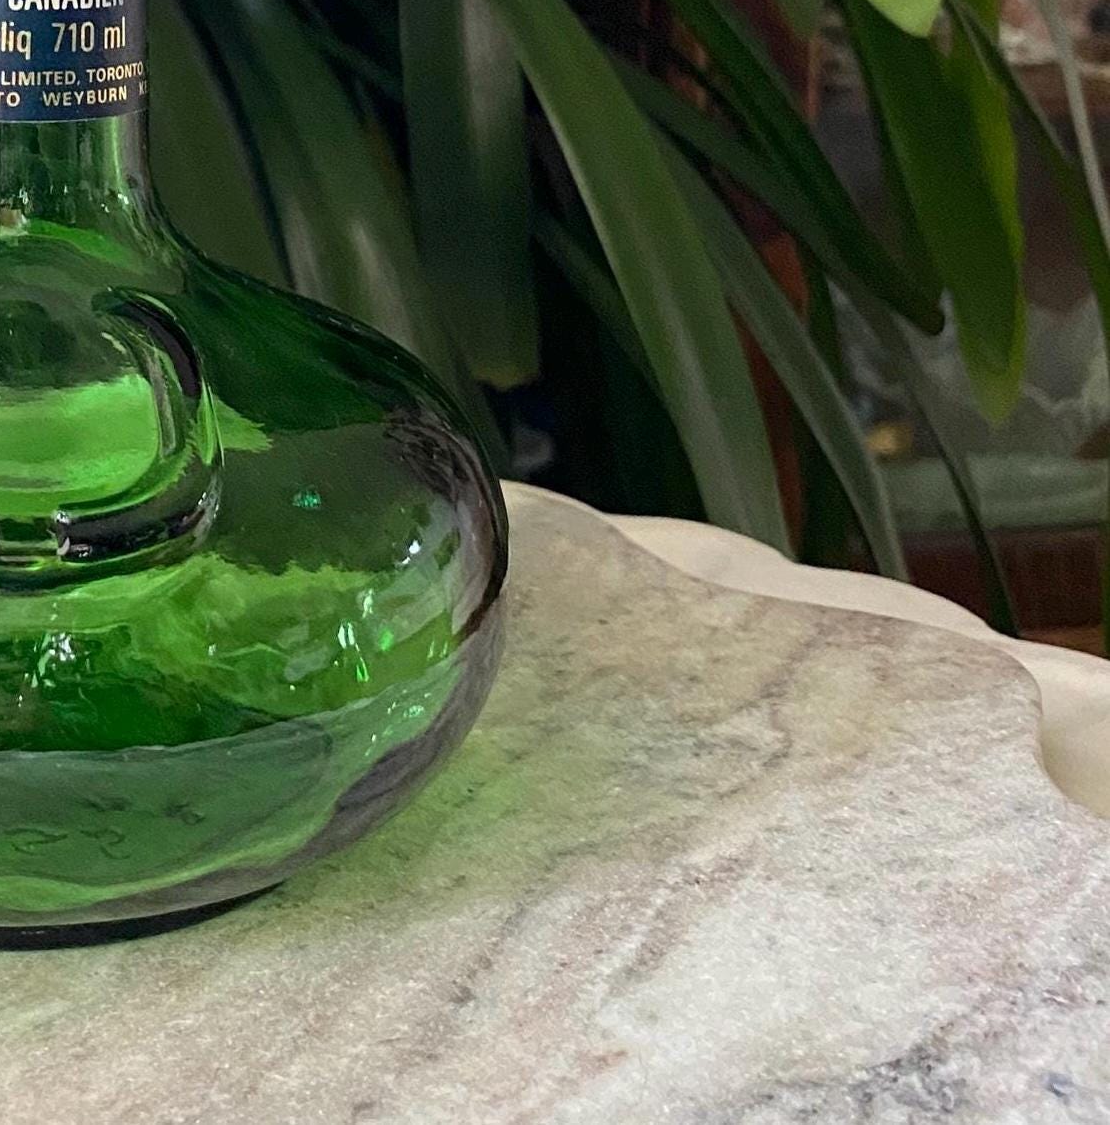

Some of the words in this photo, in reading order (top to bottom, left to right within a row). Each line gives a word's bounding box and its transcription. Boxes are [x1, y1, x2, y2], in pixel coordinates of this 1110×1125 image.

[1, 21, 32, 60] liq
[52, 21, 96, 53] 710
[104, 16, 127, 50] ml
[86, 61, 144, 83] TORONTO
[42, 85, 128, 108] WEYBURN
